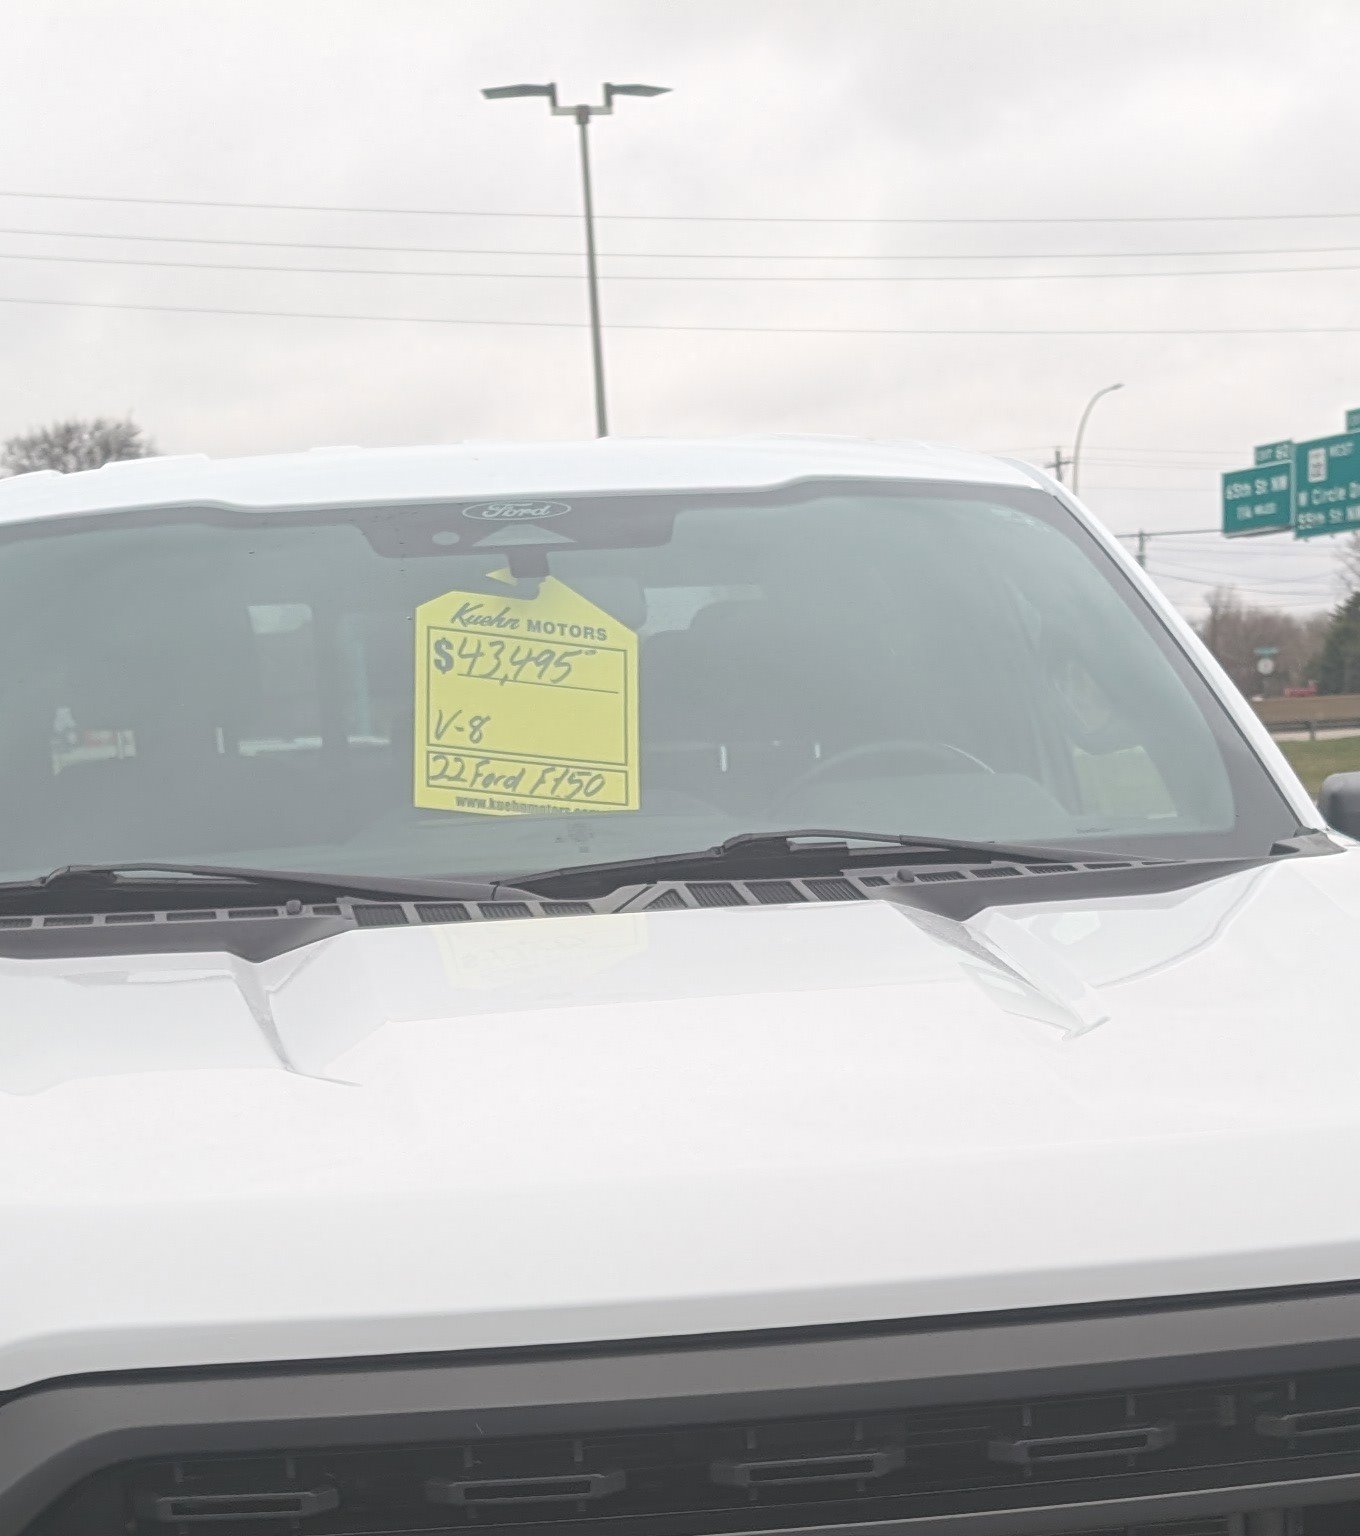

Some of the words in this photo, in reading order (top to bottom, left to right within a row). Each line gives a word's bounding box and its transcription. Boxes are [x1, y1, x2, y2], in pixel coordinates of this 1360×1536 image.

[482, 502, 551, 518] Ford
[450, 602, 521, 630] Kuehn
[527, 619, 608, 641] MOTORS
[433, 709, 492, 744] V-8
[429, 754, 468, 783] 22
[469, 757, 526, 793] Ford
